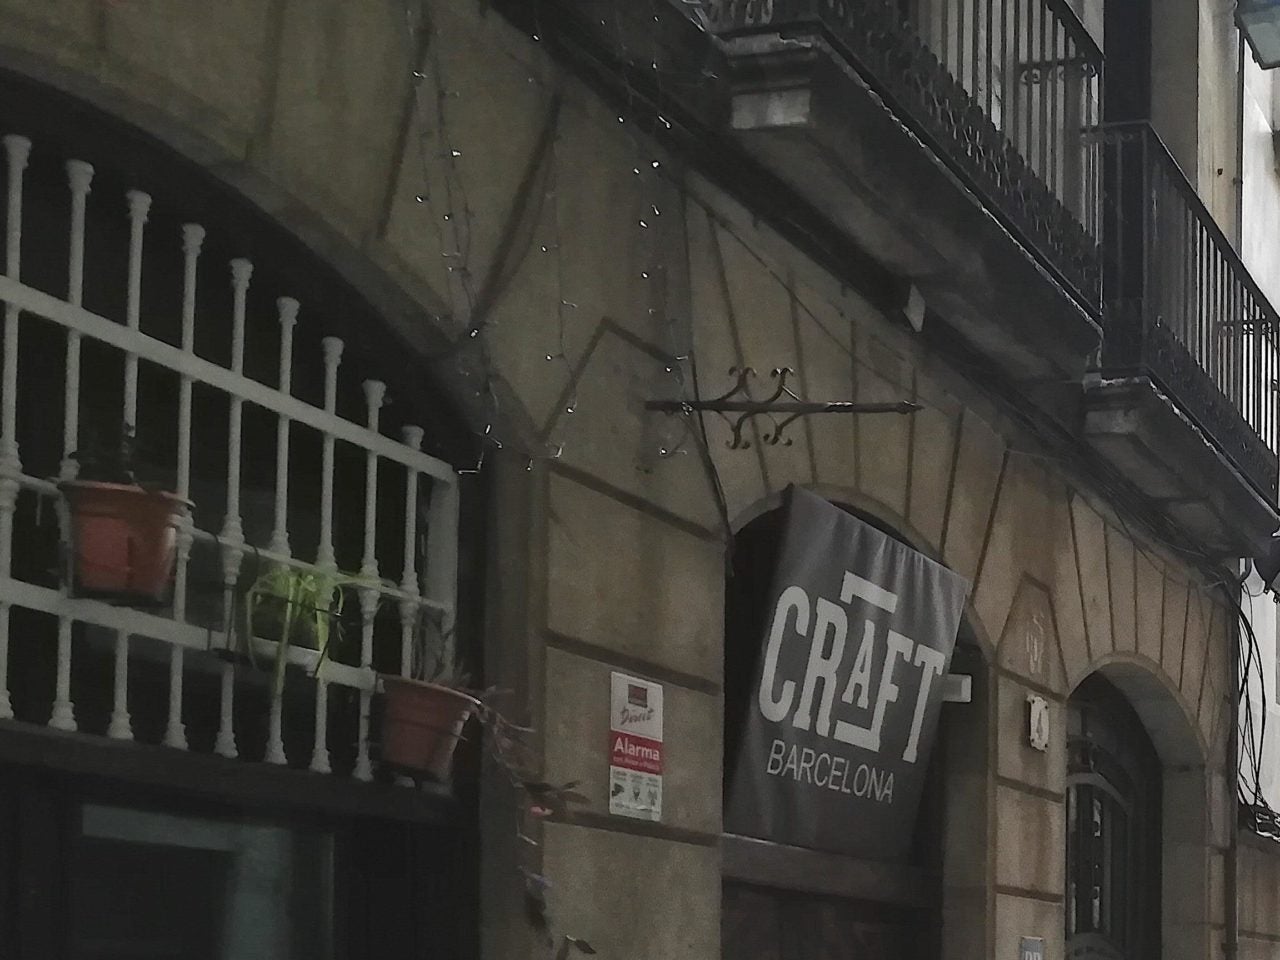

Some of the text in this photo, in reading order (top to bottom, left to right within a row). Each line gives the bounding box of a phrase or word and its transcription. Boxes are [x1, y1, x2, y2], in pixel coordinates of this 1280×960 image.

[758, 570, 946, 764] CRAFT
[613, 736, 660, 761] Alarma
[766, 739, 895, 804] BARCELONA
